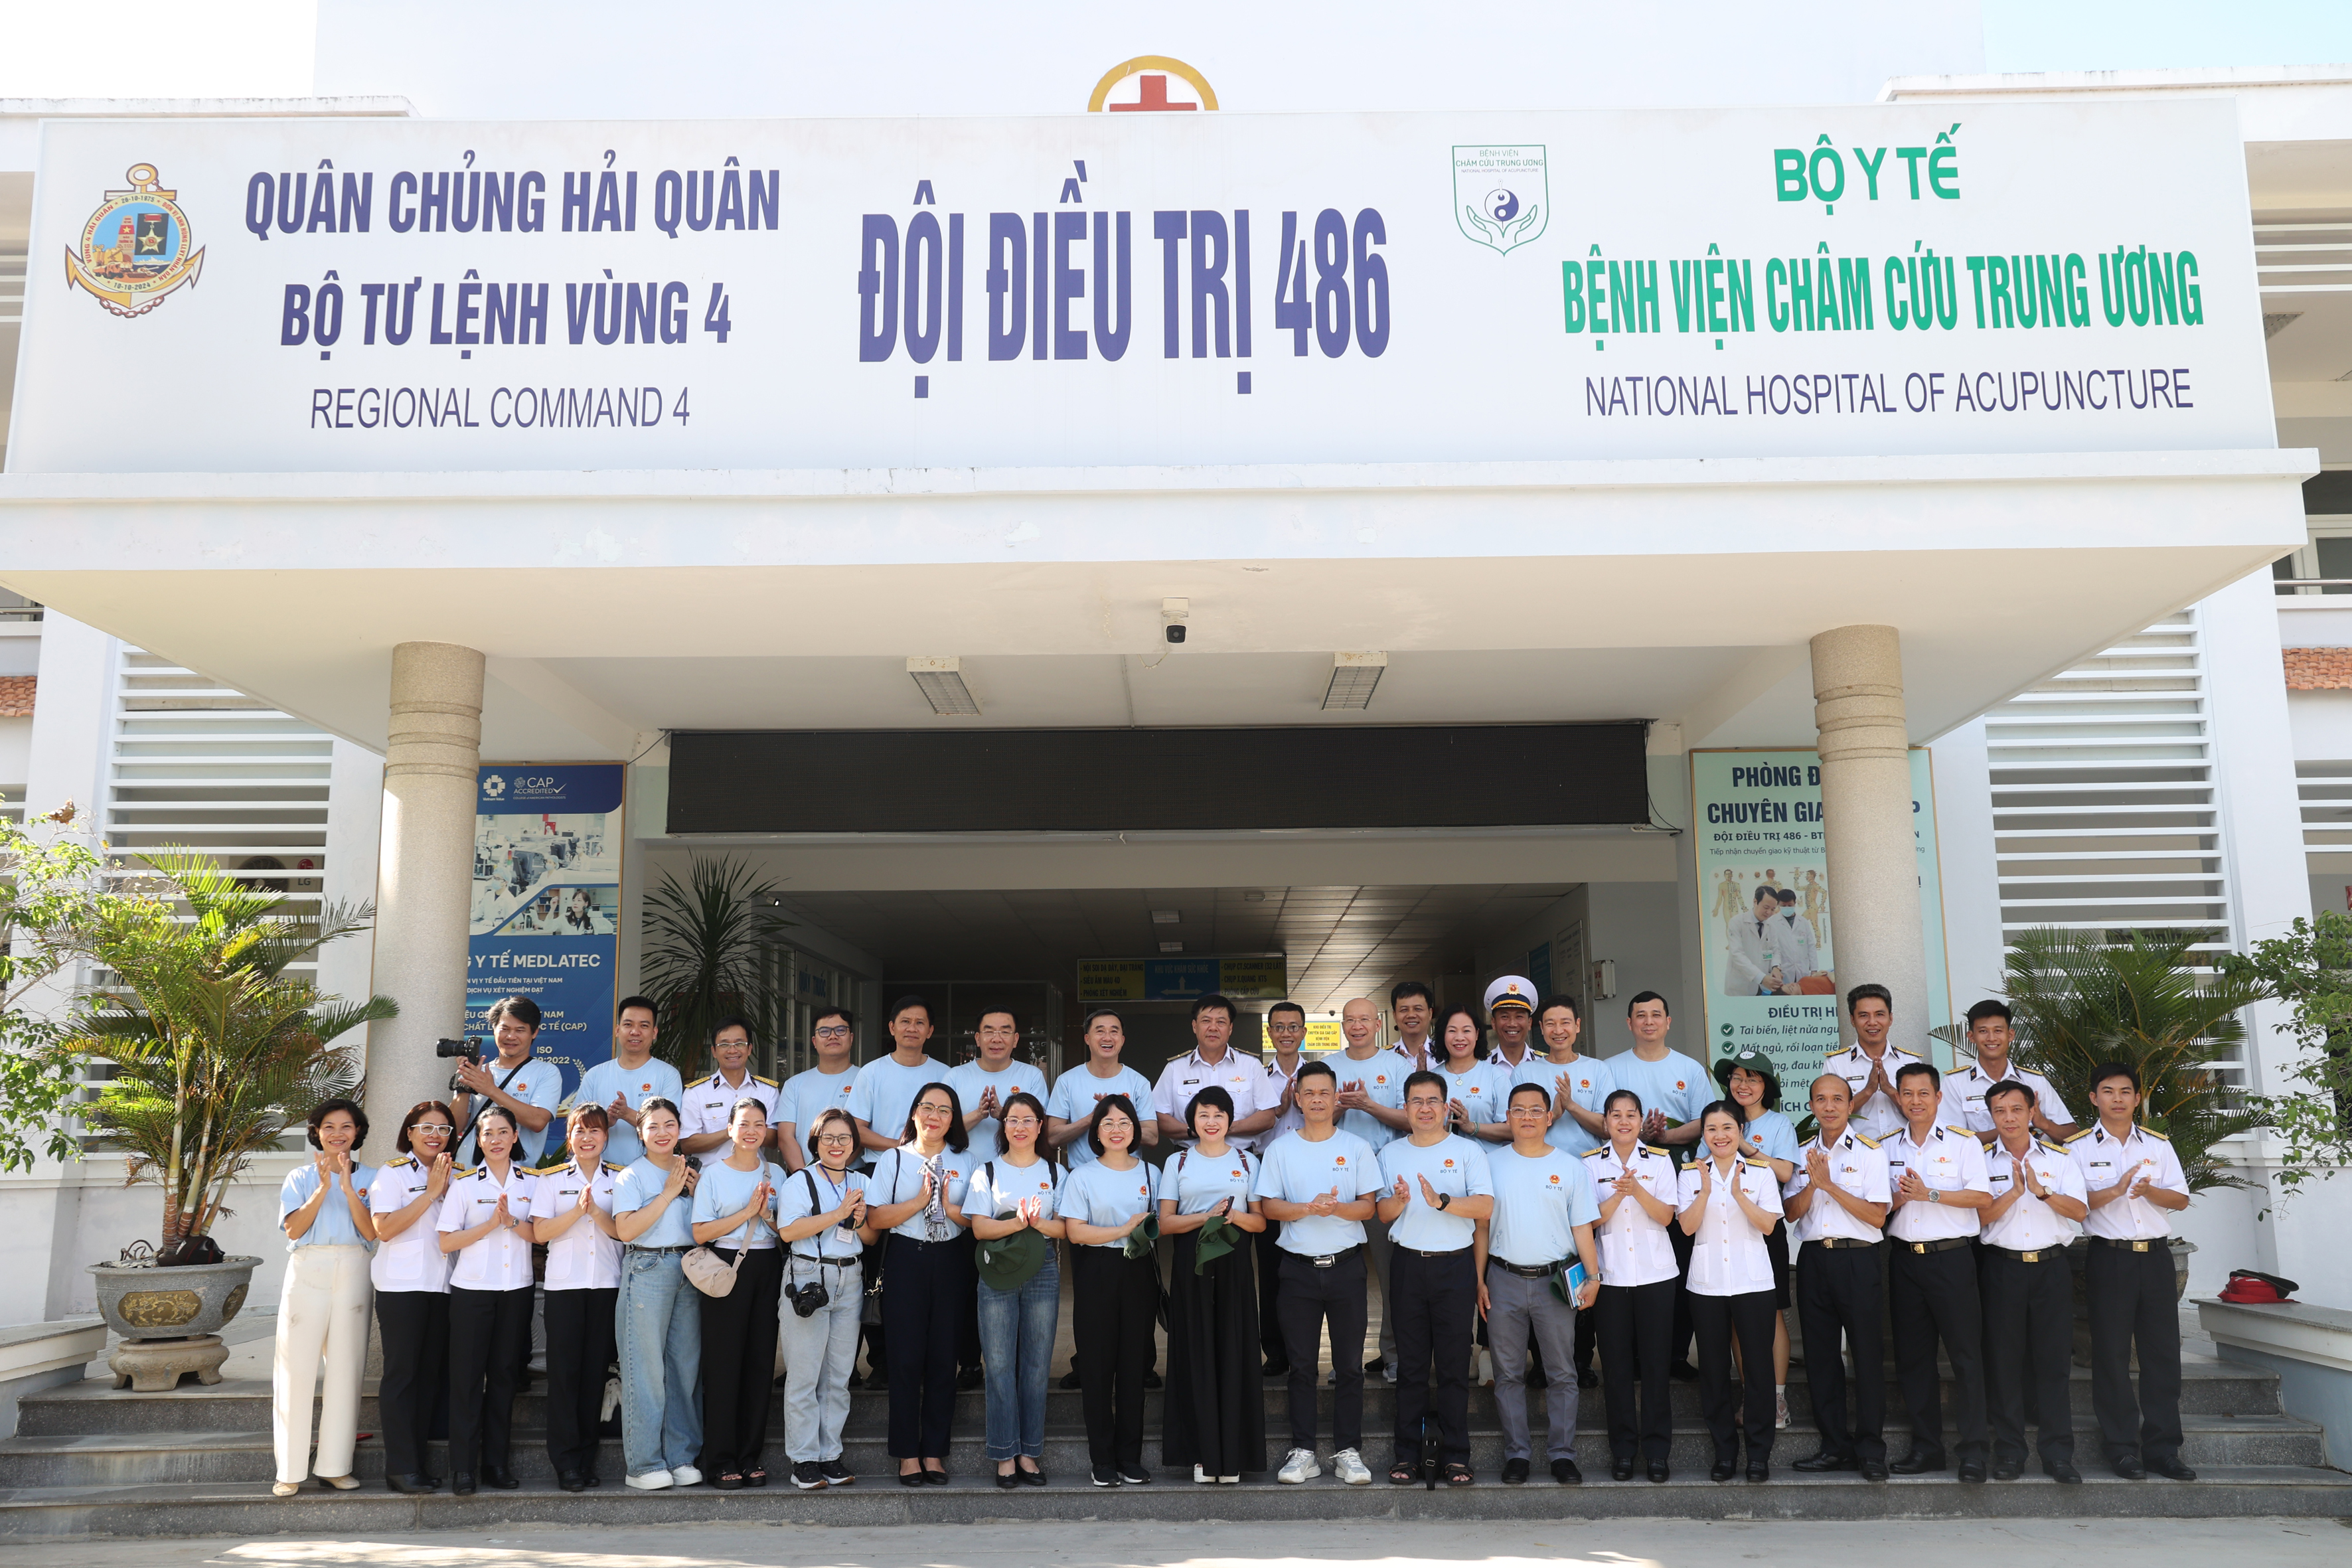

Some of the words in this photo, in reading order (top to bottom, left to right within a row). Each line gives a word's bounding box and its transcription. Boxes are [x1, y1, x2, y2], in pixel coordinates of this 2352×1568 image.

[1480, 149, 1500, 159] BỆNH
[1502, 149, 1518, 158] VIỆN
[1774, 134, 1845, 215] BỘ
[1853, 147, 1887, 200] Y
[1896, 123, 1962, 200] TẾ
[121, 195, 155, 204] 26-10-1975
[246, 159, 373, 241] QUÂN
[389, 149, 545, 233] CHỦNG
[562, 149, 637, 232] HẢI
[655, 156, 779, 239] QUÂN
[95, 204, 114, 222] QUÂN
[858, 180, 964, 398] ĐỘI
[986, 160, 1131, 362] ĐIỀU
[1154, 209, 1251, 394] TRỊ
[1275, 208, 1390, 358] 486
[1562, 244, 1660, 351] BỆNH
[1670, 243, 1755, 350] VIỆN
[1766, 242, 1874, 333] CHÂM
[1884, 240, 1958, 331] CỨU
[1966, 253, 2090, 329] TRUNG
[2098, 245, 2203, 327] ƯƠNG
[281, 270, 343, 360] BỘ
[360, 276, 422, 346] TƯ
[430, 269, 549, 359] LỆNH
[566, 269, 688, 345] VÙNG
[704, 283, 731, 343] 4
[1586, 376, 1738, 416] NATIONAL
[1747, 374, 1897, 415] HOSPITAL
[1905, 372, 1944, 412] OF
[1956, 368, 2193, 412] ACUPUNCTURE
[311, 388, 479, 428] REGIONAL
[491, 387, 662, 428] COMMAND
[673, 387, 690, 426] 4
[527, 777, 554, 788] CAP
[1733, 762, 1802, 787] PHÒNG
[1707, 798, 1788, 823] CHUYÊN
[1713, 831, 1733, 842] ĐỘI
[1736, 830, 1760, 841] ĐIỀU
[1763, 832, 1780, 842] TRỊ
[1709, 848, 1723, 856] Tiếp
[475, 955, 486, 968] Y
[489, 949, 511, 968] TẾ
[513, 954, 600, 967] MEDLATEC
[1768, 1004, 1799, 1018] ĐIỀU
[1802, 1007, 1822, 1020] TRỊ
[549, 1020, 560, 1030] TẾ
[562, 1023, 587, 1032] (CAP)
[1740, 1026, 1754, 1034] Tai
[1757, 1024, 1780, 1036] biến,
[1782, 1025, 1798, 1036] liệt
[1800, 1024, 1818, 1034] nửa
[1763, 1042, 1783, 1054] ngủ,
[1786, 1042, 1799, 1052] rối
[1802, 1042, 1823, 1054] loạn
